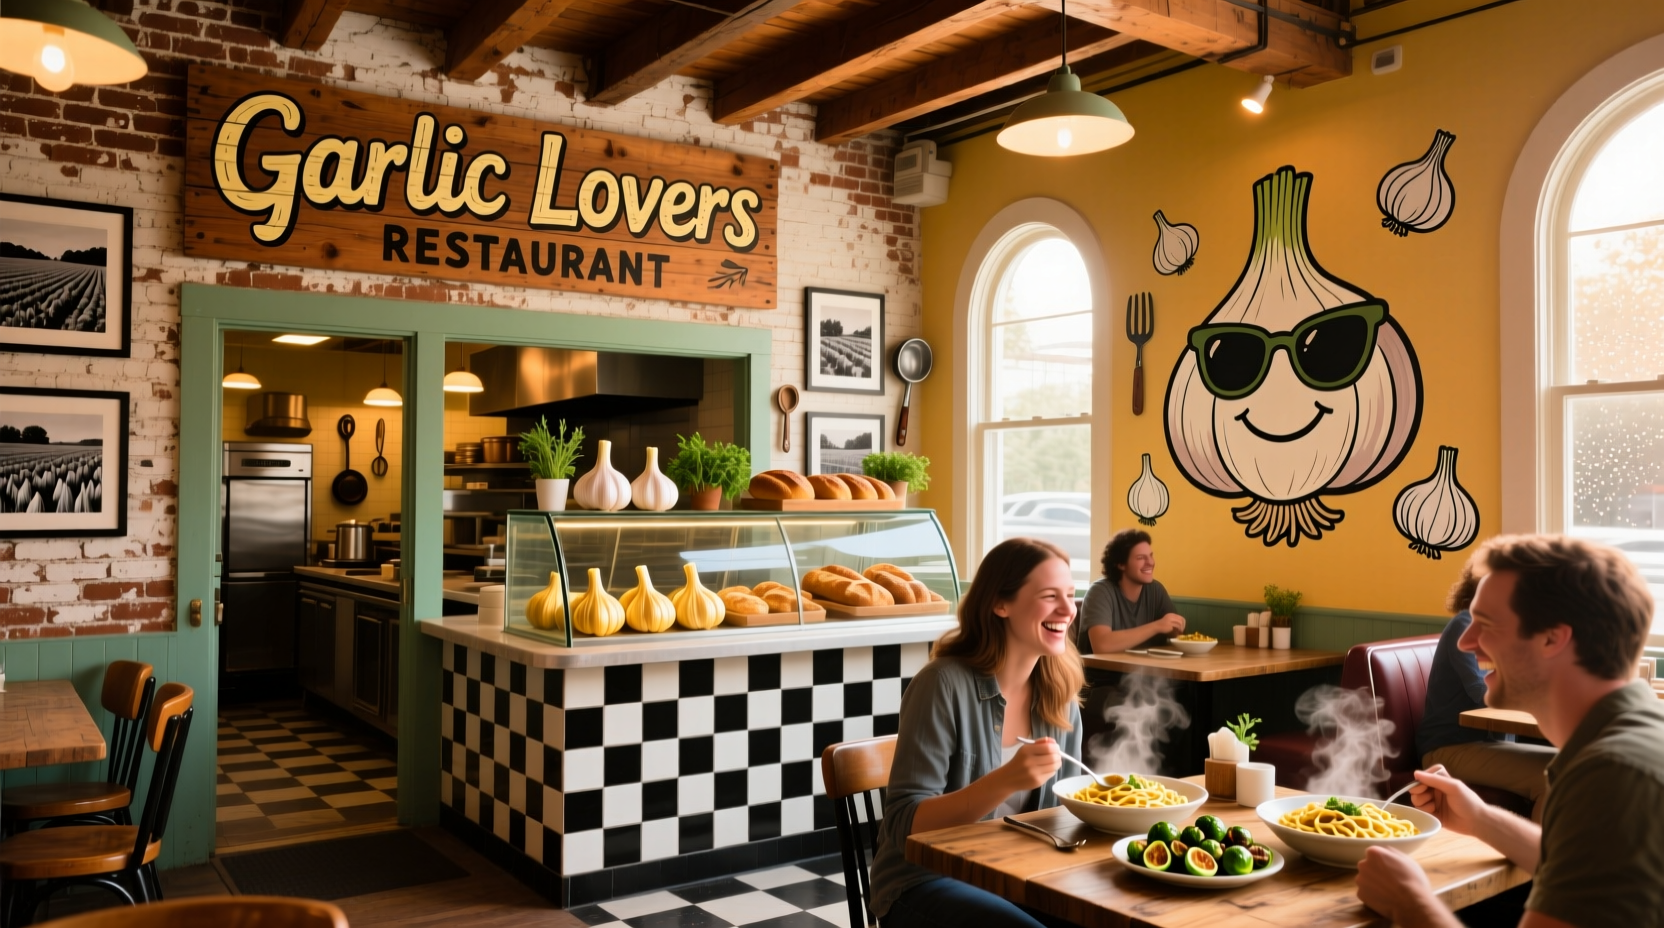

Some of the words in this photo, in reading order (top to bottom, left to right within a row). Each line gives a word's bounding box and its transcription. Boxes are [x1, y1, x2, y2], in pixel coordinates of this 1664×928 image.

[212, 91, 510, 246] Garlic
[530, 132, 761, 251] Lovers
[383, 224, 670, 288] RESTAURANT
